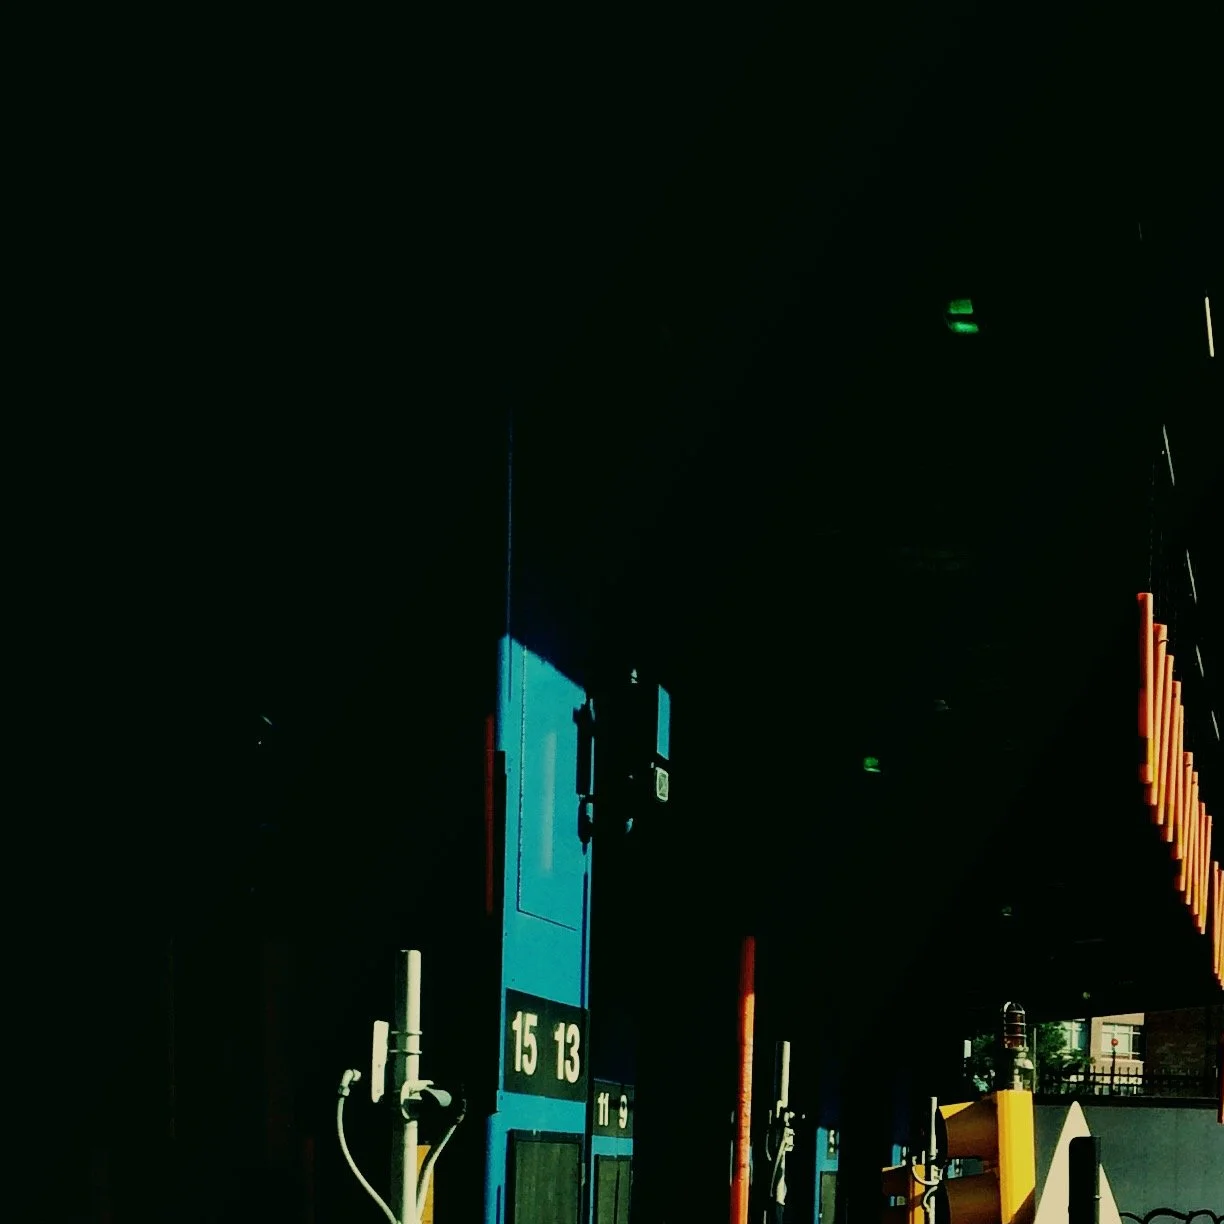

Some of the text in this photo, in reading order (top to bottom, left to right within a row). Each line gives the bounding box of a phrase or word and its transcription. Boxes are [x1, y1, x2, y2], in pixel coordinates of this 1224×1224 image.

[512, 1010, 581, 1084] 15 13
[597, 1091, 610, 1127] 11
